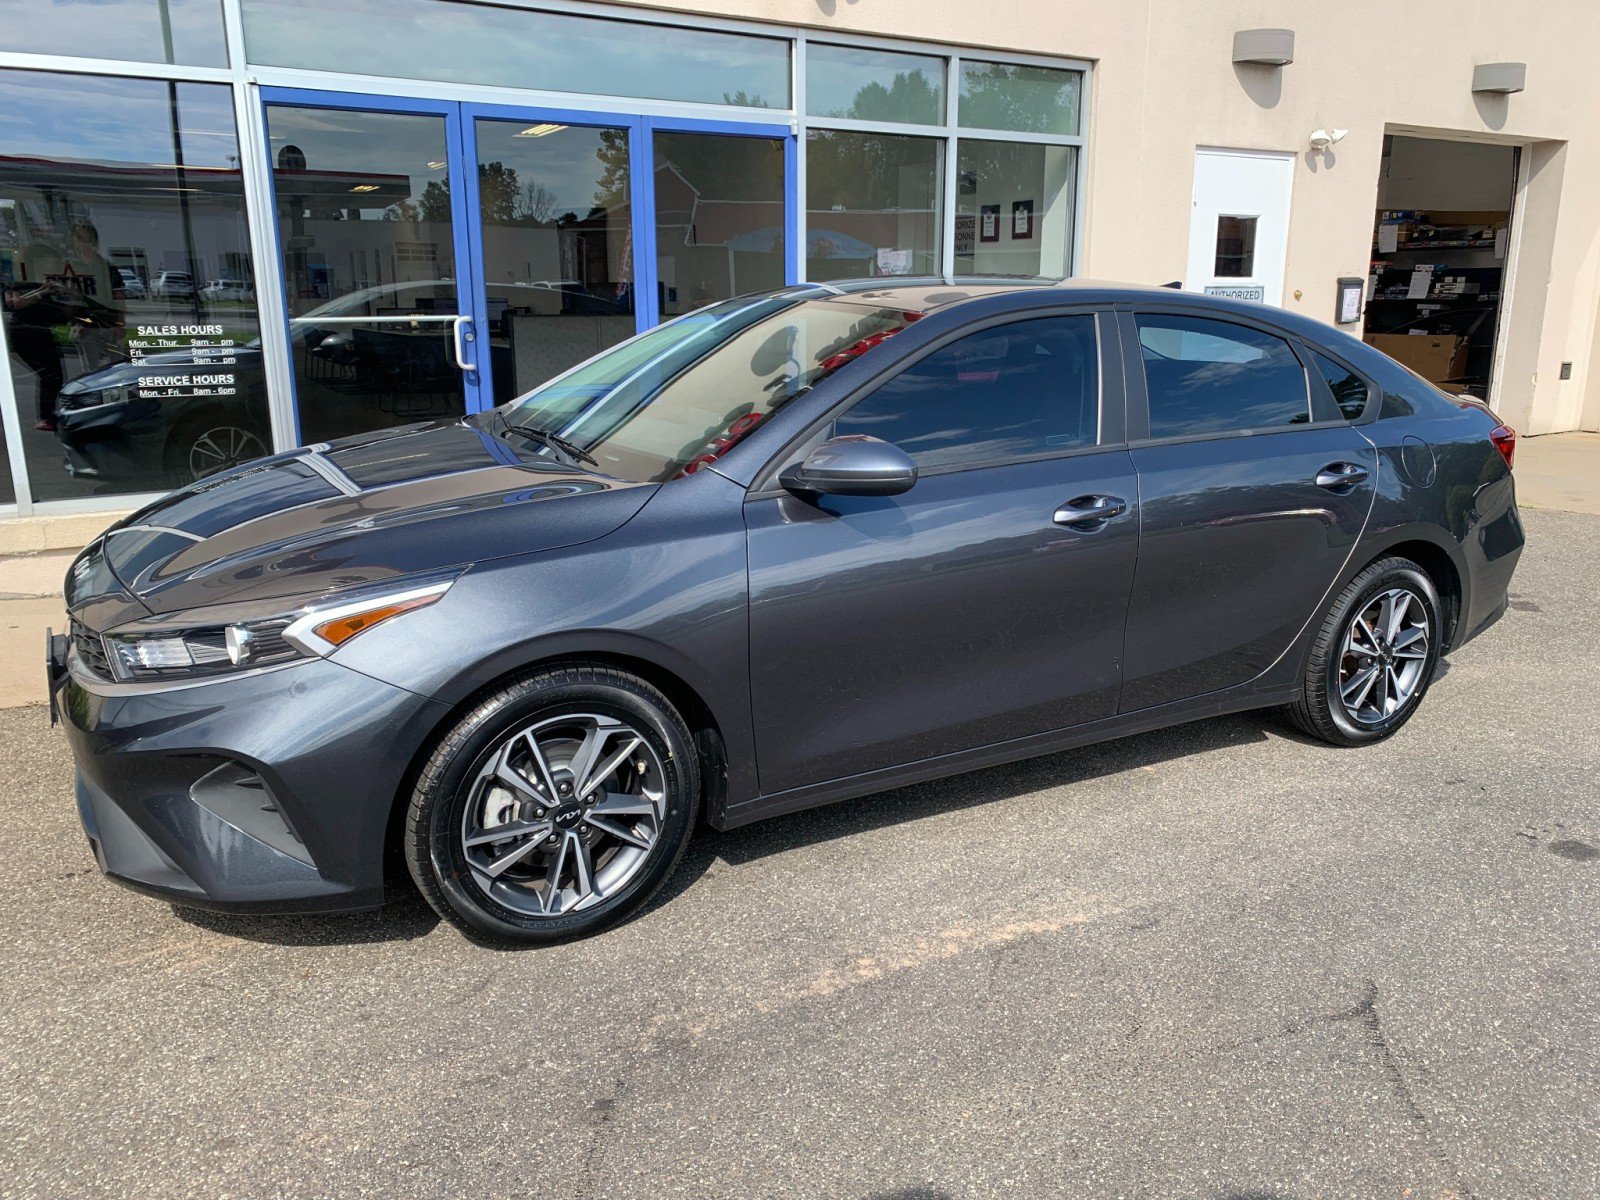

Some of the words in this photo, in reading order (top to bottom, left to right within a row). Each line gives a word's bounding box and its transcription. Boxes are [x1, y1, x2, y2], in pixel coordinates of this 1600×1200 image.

[137, 326, 178, 335] SALES
[180, 325, 223, 335] HOURS
[190, 339, 209, 347] 9am
[193, 357, 212, 365] 9am
[138, 376, 191, 386] SERVICE
[192, 374, 235, 384] HOURS
[193, 387, 212, 395] 8am
[217, 386, 236, 395] 6pm
